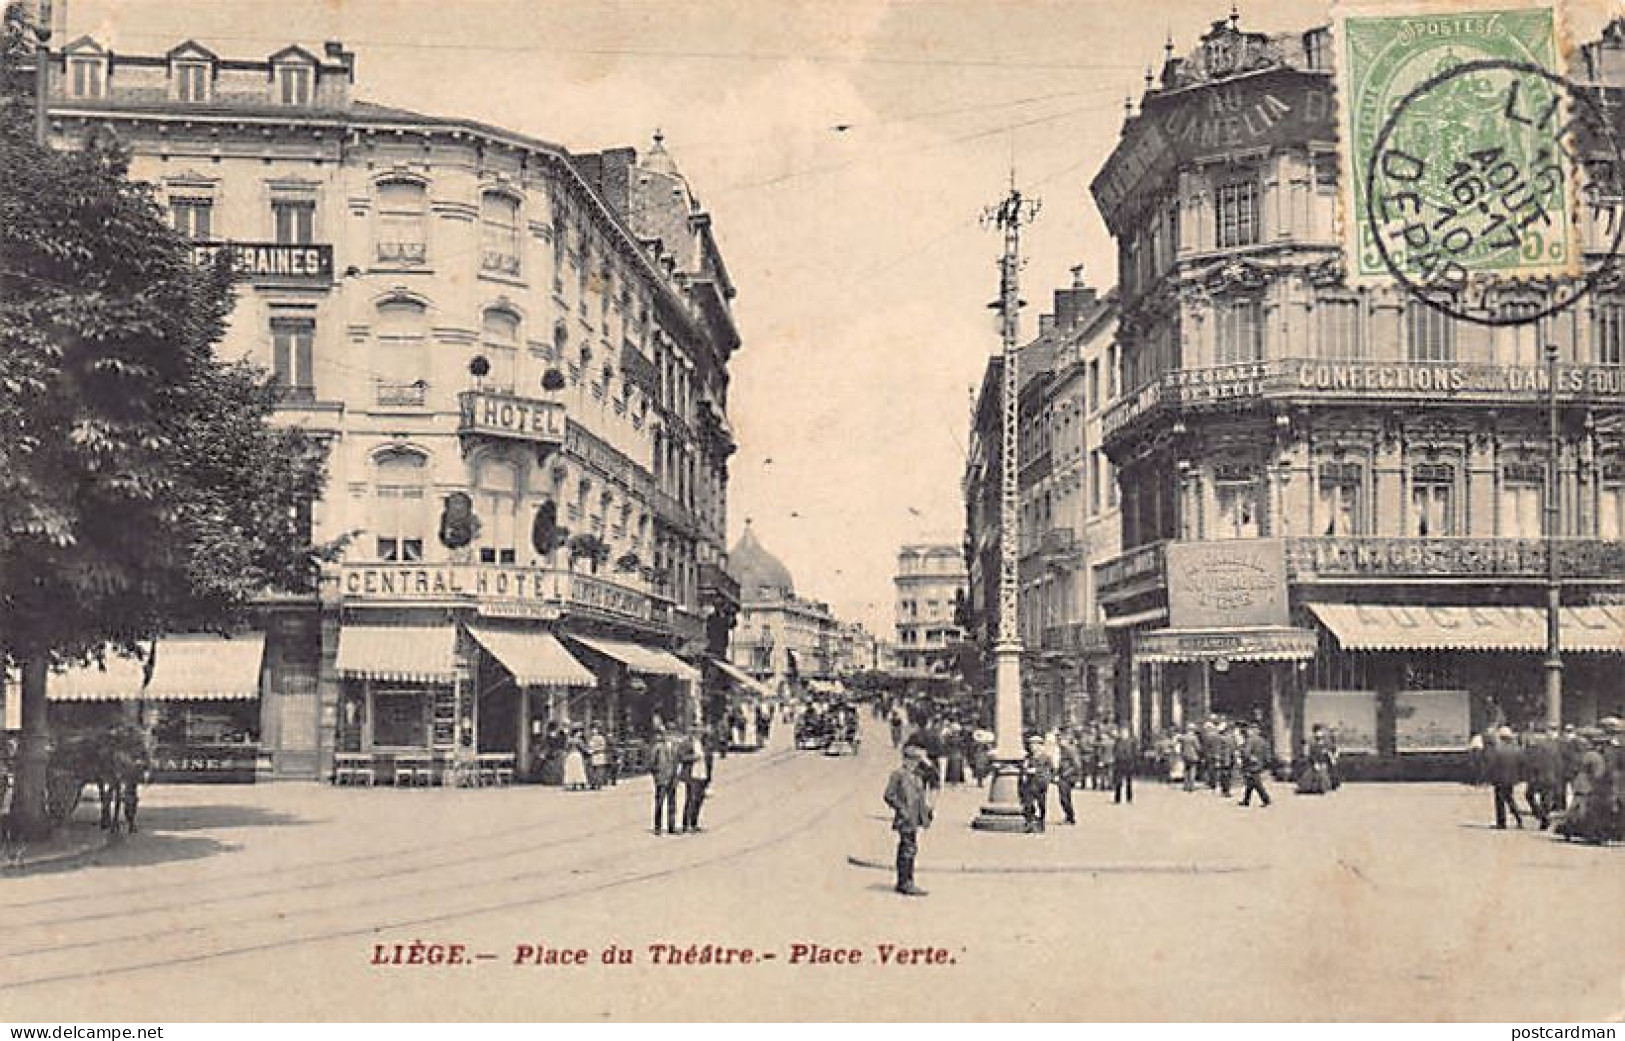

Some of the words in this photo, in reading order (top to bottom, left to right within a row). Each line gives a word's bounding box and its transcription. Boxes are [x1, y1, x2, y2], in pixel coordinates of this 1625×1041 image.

[1469, 147, 1552, 228] AOUT
[1299, 364, 1463, 390] CONFECTIONS
[1588, 368, 1625, 394] FOU
[484, 402, 560, 434] HOTEL
[347, 570, 462, 592] CENTRAL
[477, 569, 563, 598] HOTEL
